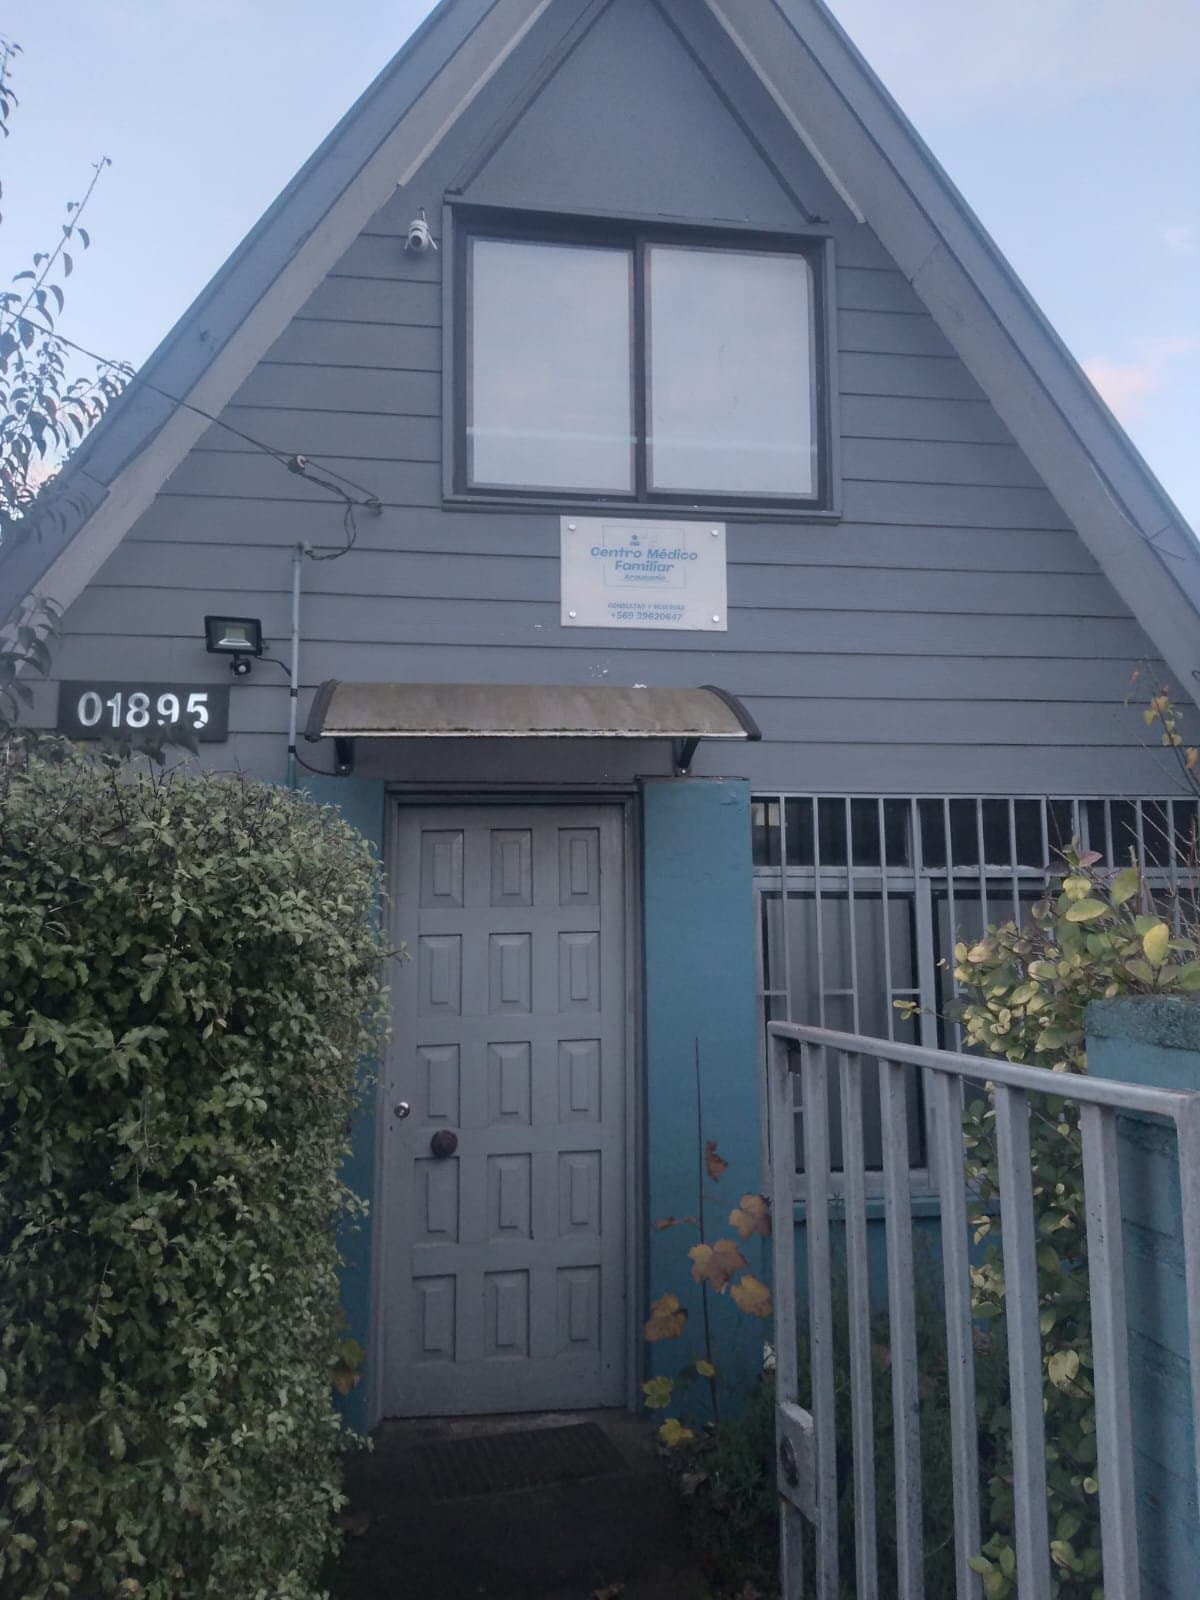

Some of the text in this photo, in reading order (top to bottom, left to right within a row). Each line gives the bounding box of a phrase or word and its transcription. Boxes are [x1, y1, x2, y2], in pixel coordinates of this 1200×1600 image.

[591, 546, 698, 561] Centro Médico
[615, 560, 674, 572] Familiar
[77, 691, 209, 729] 01895
